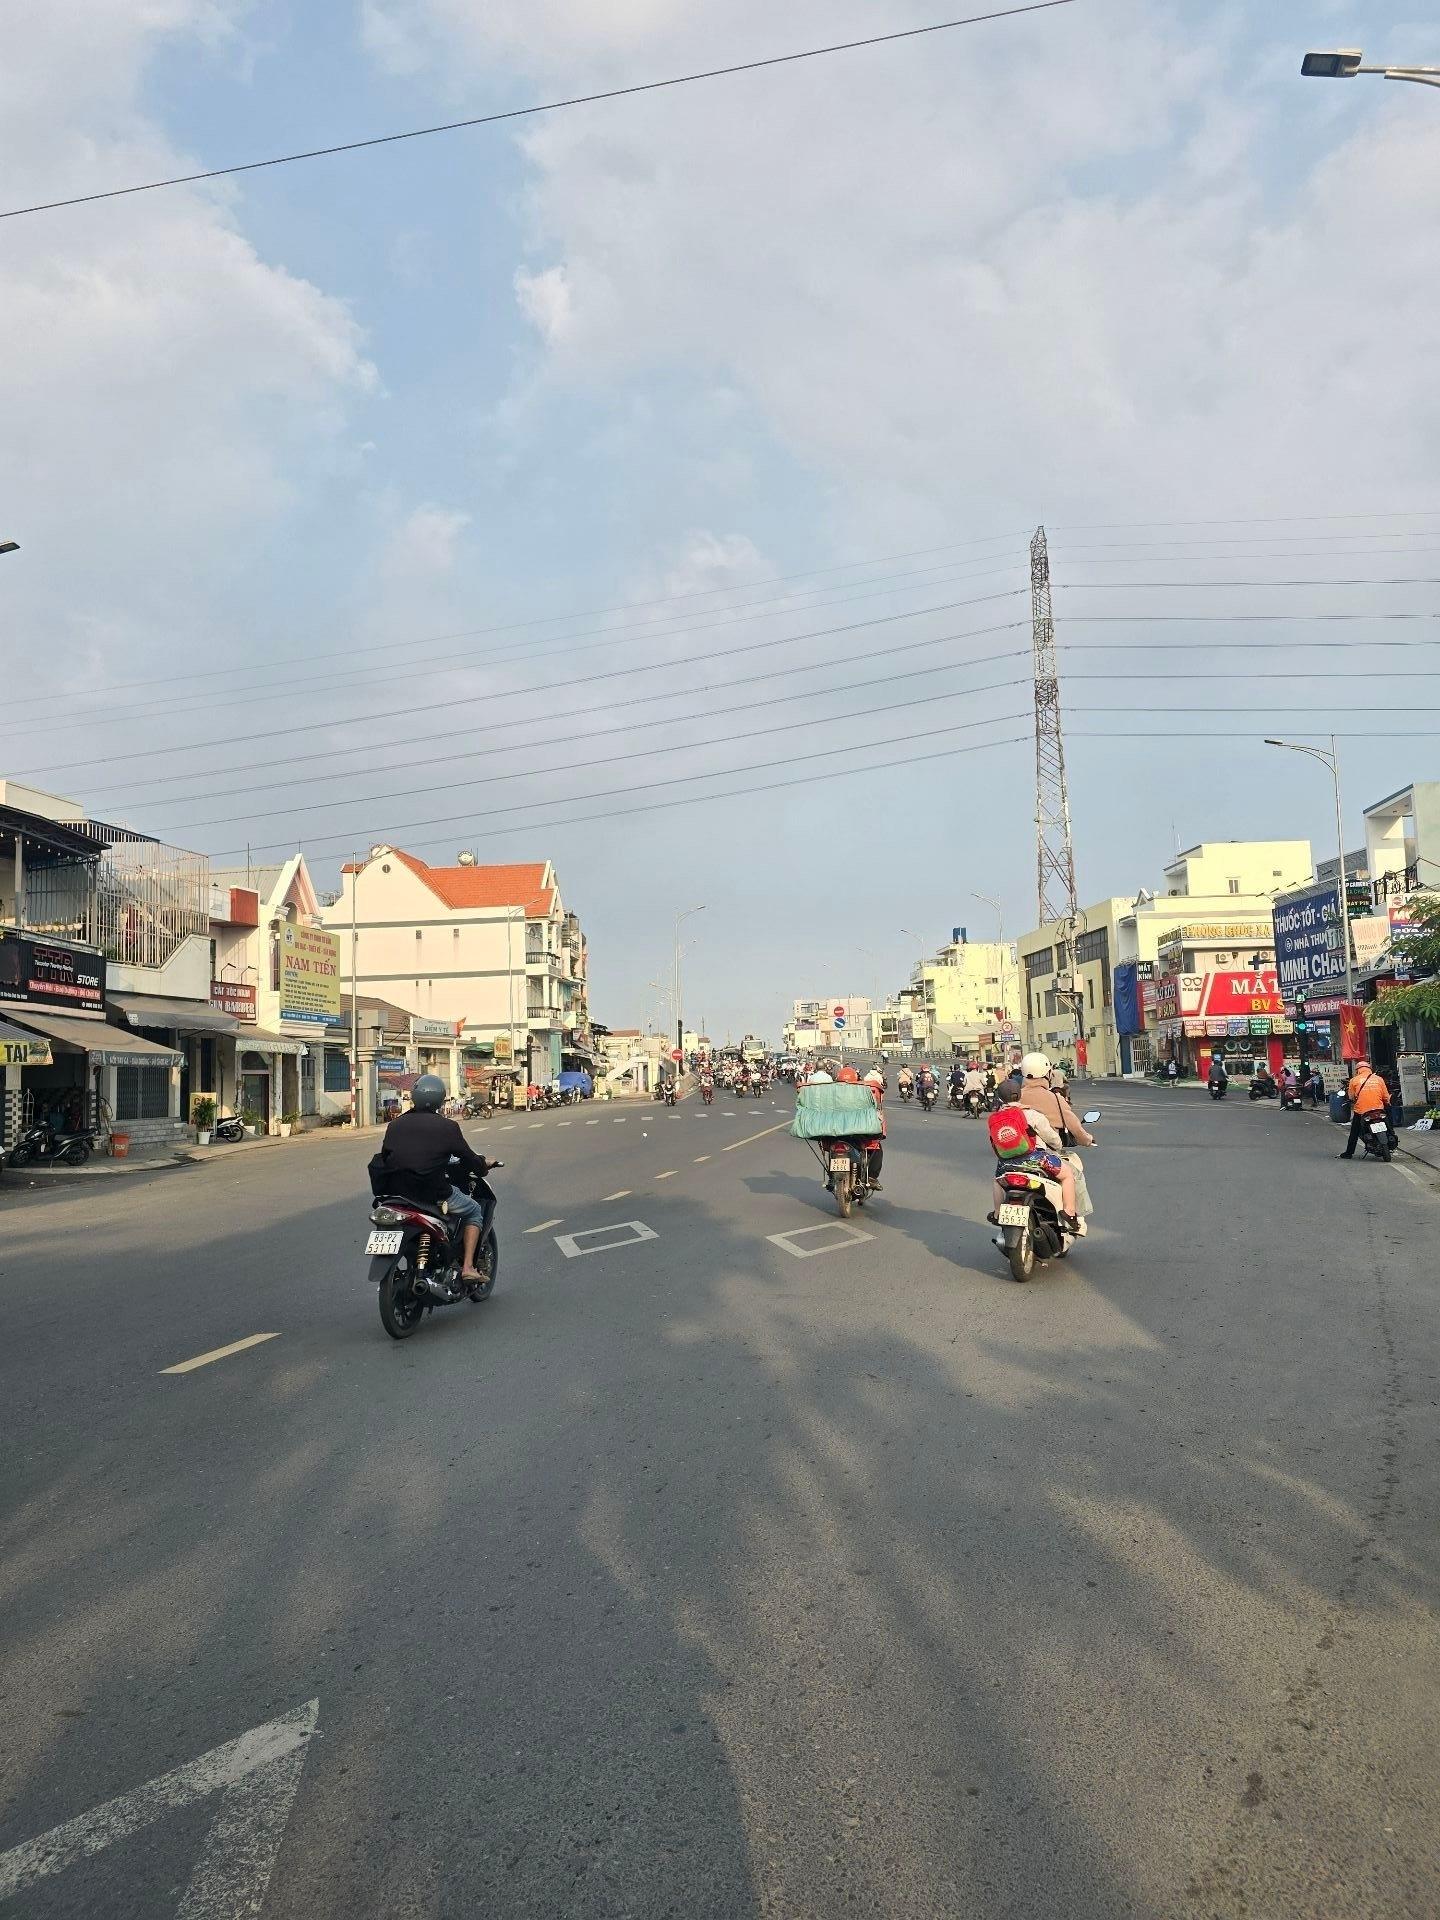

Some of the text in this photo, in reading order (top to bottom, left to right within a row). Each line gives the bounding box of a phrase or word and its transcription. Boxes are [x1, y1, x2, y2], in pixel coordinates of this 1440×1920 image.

[1275, 907, 1300, 933] THUỐC
[1301, 902, 1316, 927] TỐT
[1293, 933, 1310, 951] NHÀ
[286, 955, 337, 977] NAM TIẾN
[1280, 957, 1310, 982] MINH
[77, 974, 100, 987] STORE
[1251, 998, 1270, 1011] BV
[4, 1044, 28, 1063] TAI
